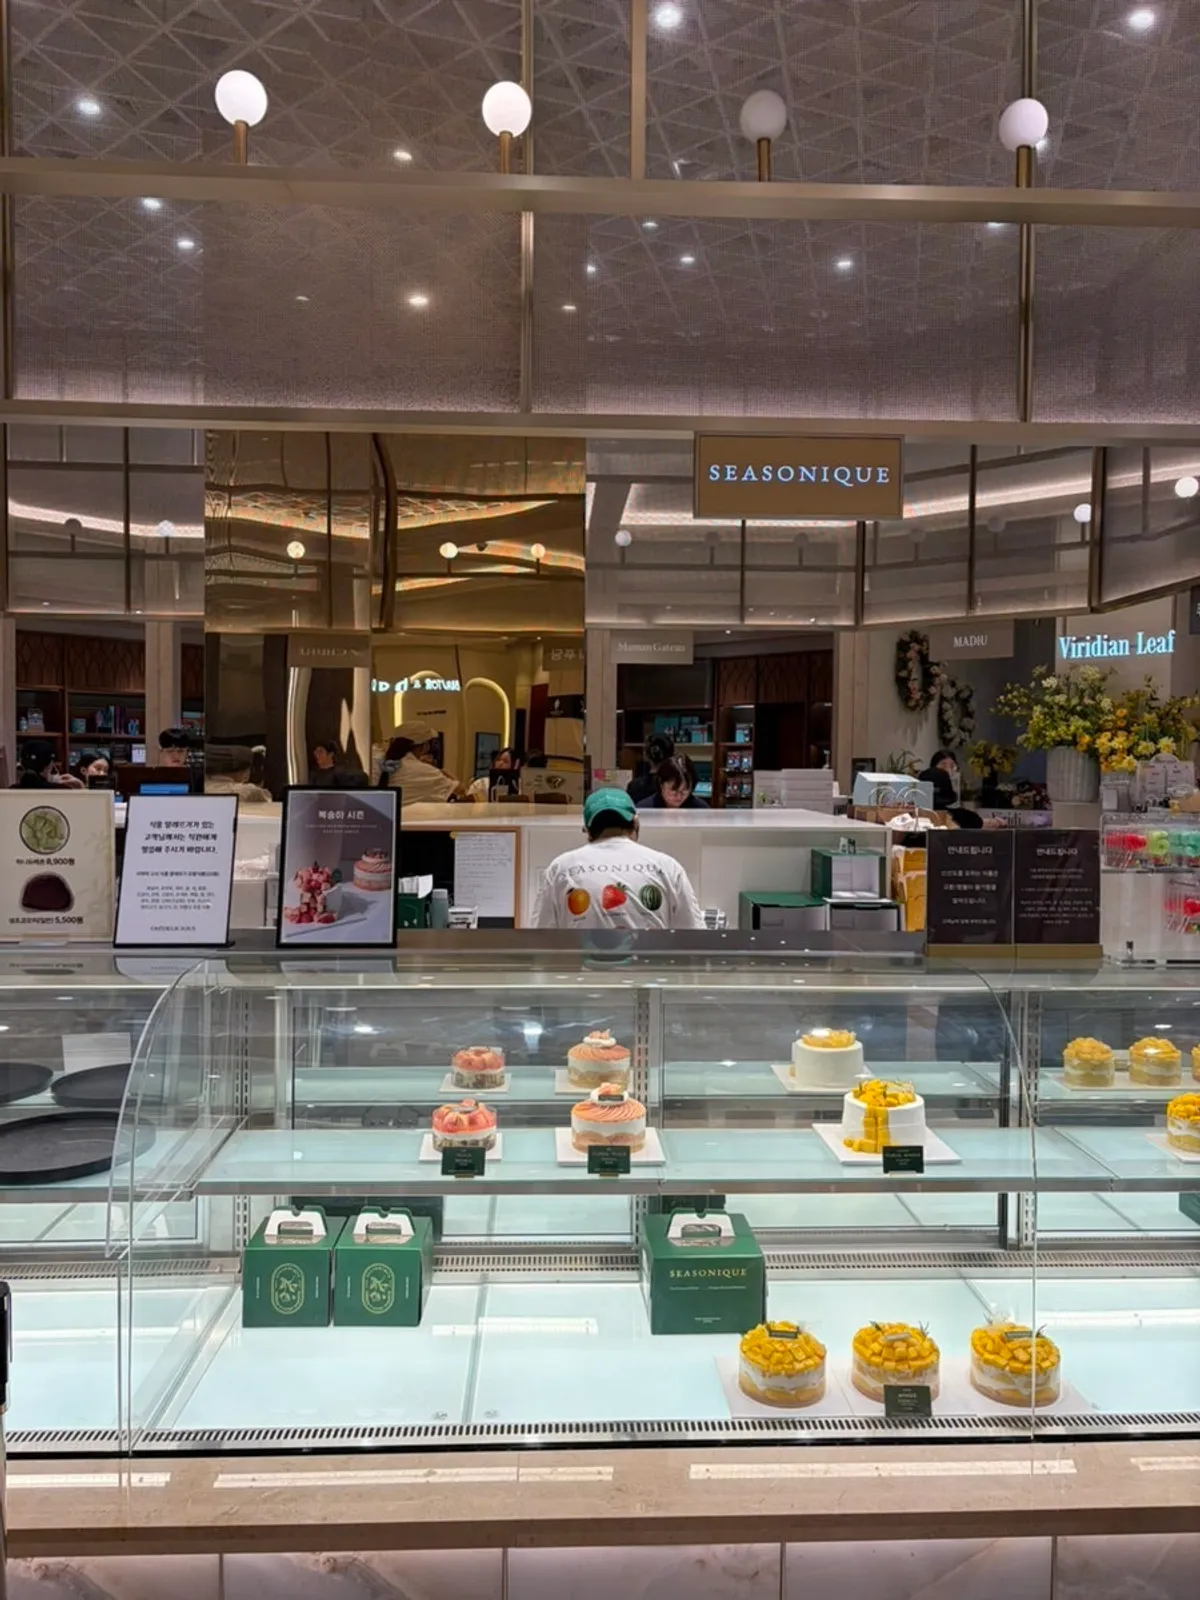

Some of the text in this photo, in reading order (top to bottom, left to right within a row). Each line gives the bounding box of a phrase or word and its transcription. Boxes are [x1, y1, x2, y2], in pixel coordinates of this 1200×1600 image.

[708, 464, 890, 487] SEASONIQUE
[1059, 630, 1176, 660] Viridian Leaf
[669, 1268, 747, 1278] SEASONIQUE
